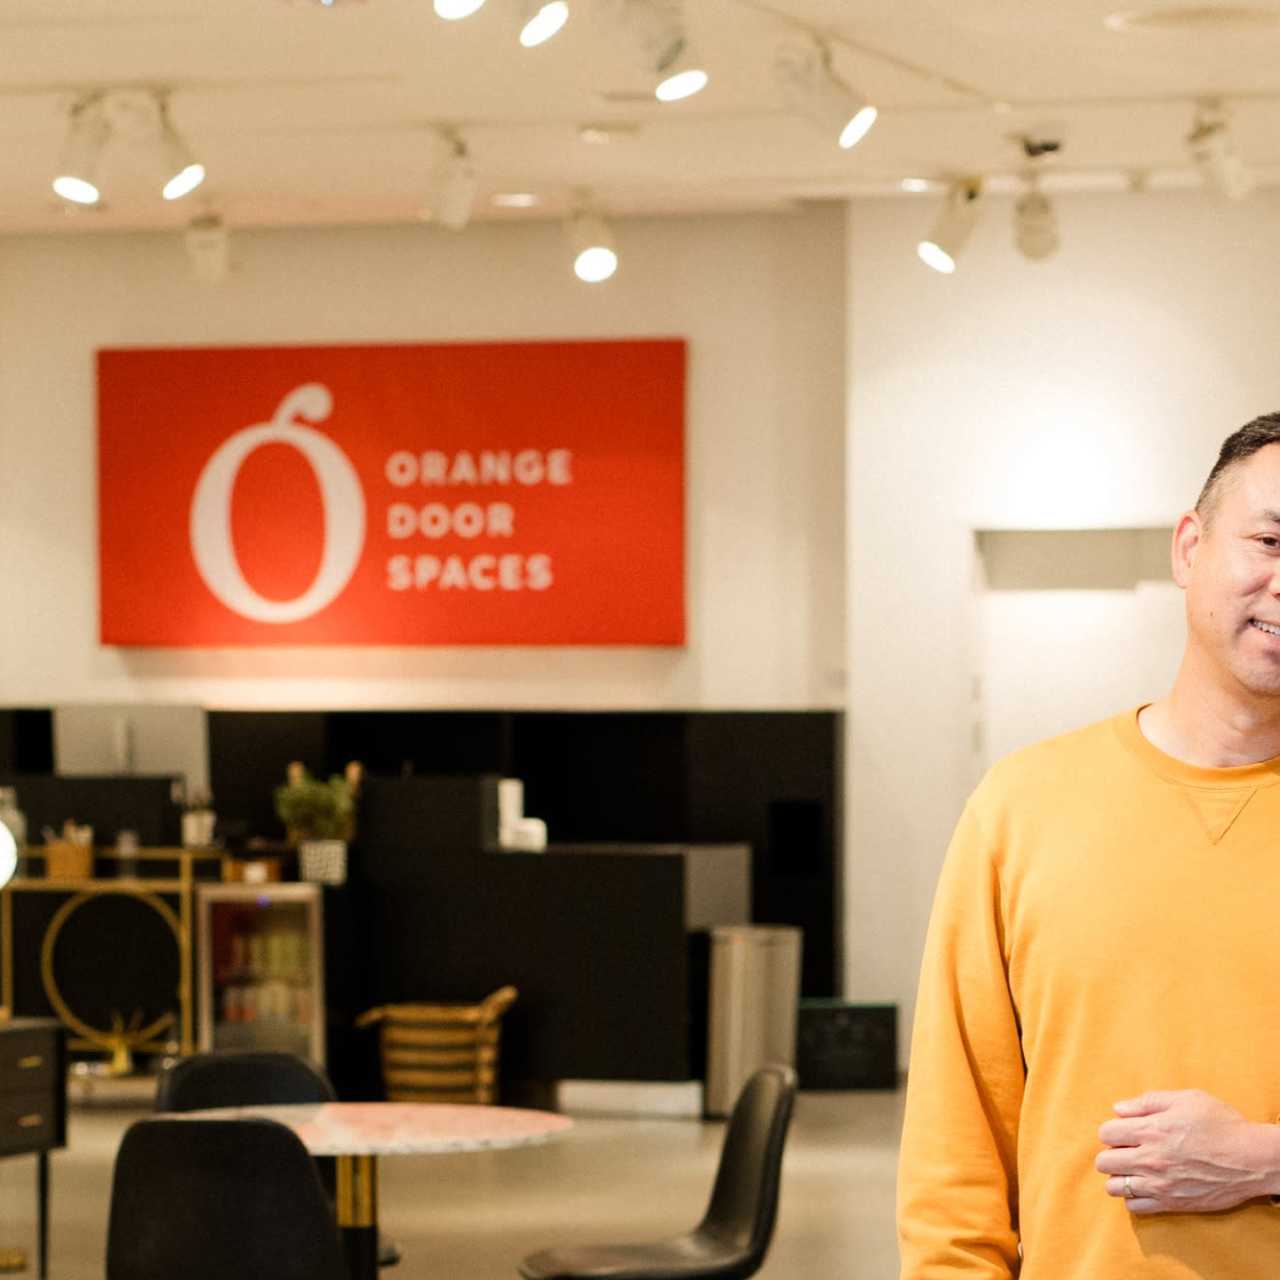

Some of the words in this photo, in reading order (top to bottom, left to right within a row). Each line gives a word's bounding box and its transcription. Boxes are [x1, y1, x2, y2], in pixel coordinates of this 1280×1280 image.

[386, 450, 571, 487] ORANGE
[387, 503, 514, 539] DOOR
[387, 554, 552, 591] SPACES
